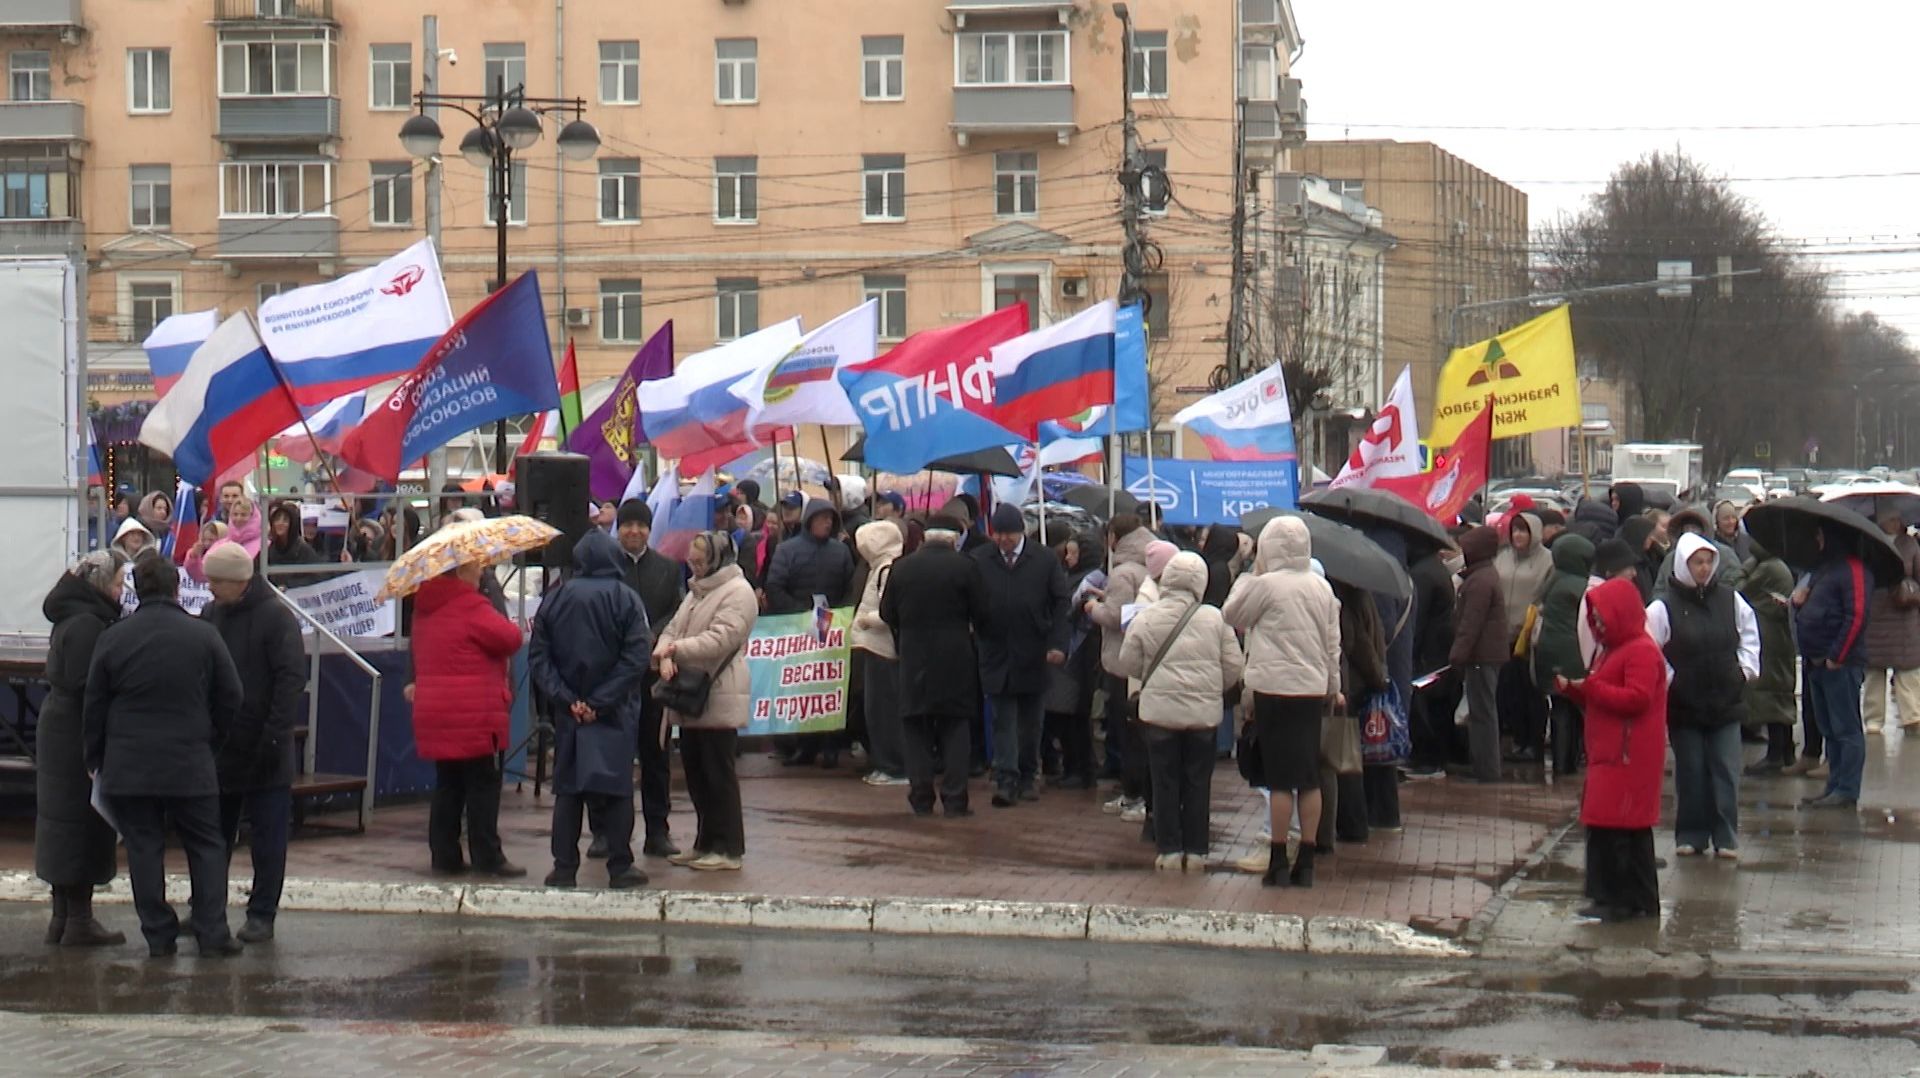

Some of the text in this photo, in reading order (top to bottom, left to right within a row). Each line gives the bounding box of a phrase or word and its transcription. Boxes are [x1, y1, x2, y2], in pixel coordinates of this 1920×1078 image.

[419, 363, 491, 414] ИЗАЦИЙ
[402, 385, 498, 448] ОФСОЮЗОВ
[782, 661, 843, 685] весны
[775, 688, 842, 721] труда!
